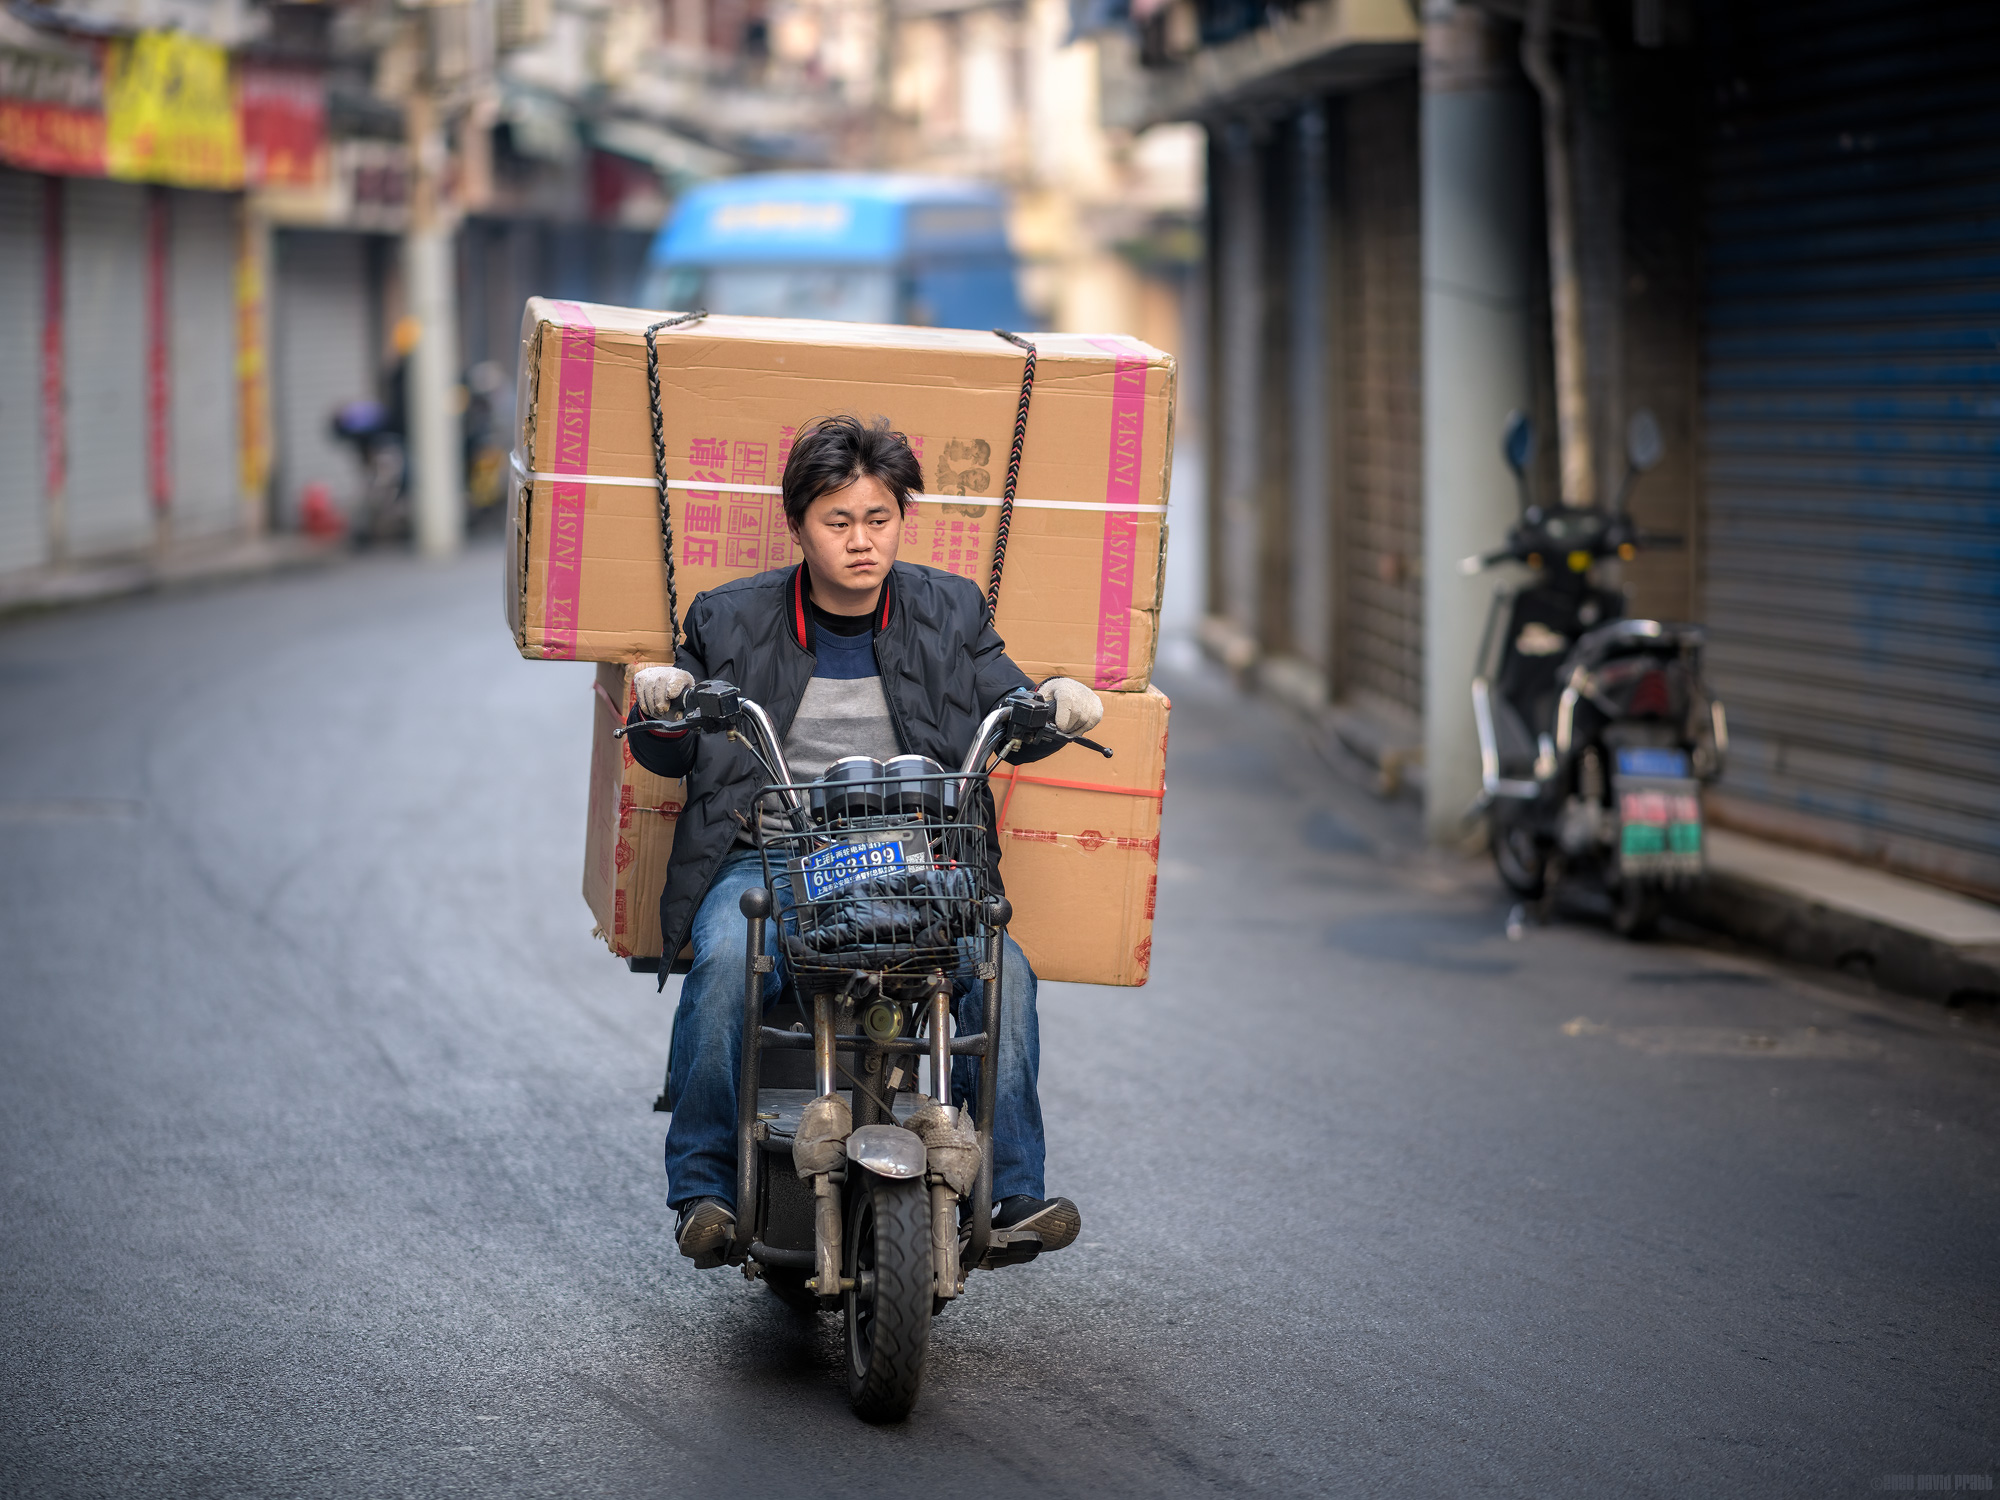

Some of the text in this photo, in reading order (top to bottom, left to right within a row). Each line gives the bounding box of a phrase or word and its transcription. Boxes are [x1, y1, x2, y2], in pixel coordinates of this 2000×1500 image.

[562, 388, 585, 467] YASINI
[1115, 411, 1138, 487] YASINI
[555, 493, 578, 571] YASINI
[682, 437, 728, 568] 请勿重压
[931, 519, 946, 563] 3C认证
[964, 522, 980, 581] 本产品已
[1108, 512, 1130, 587] YASINI
[813, 846, 896, 887] 6003199
